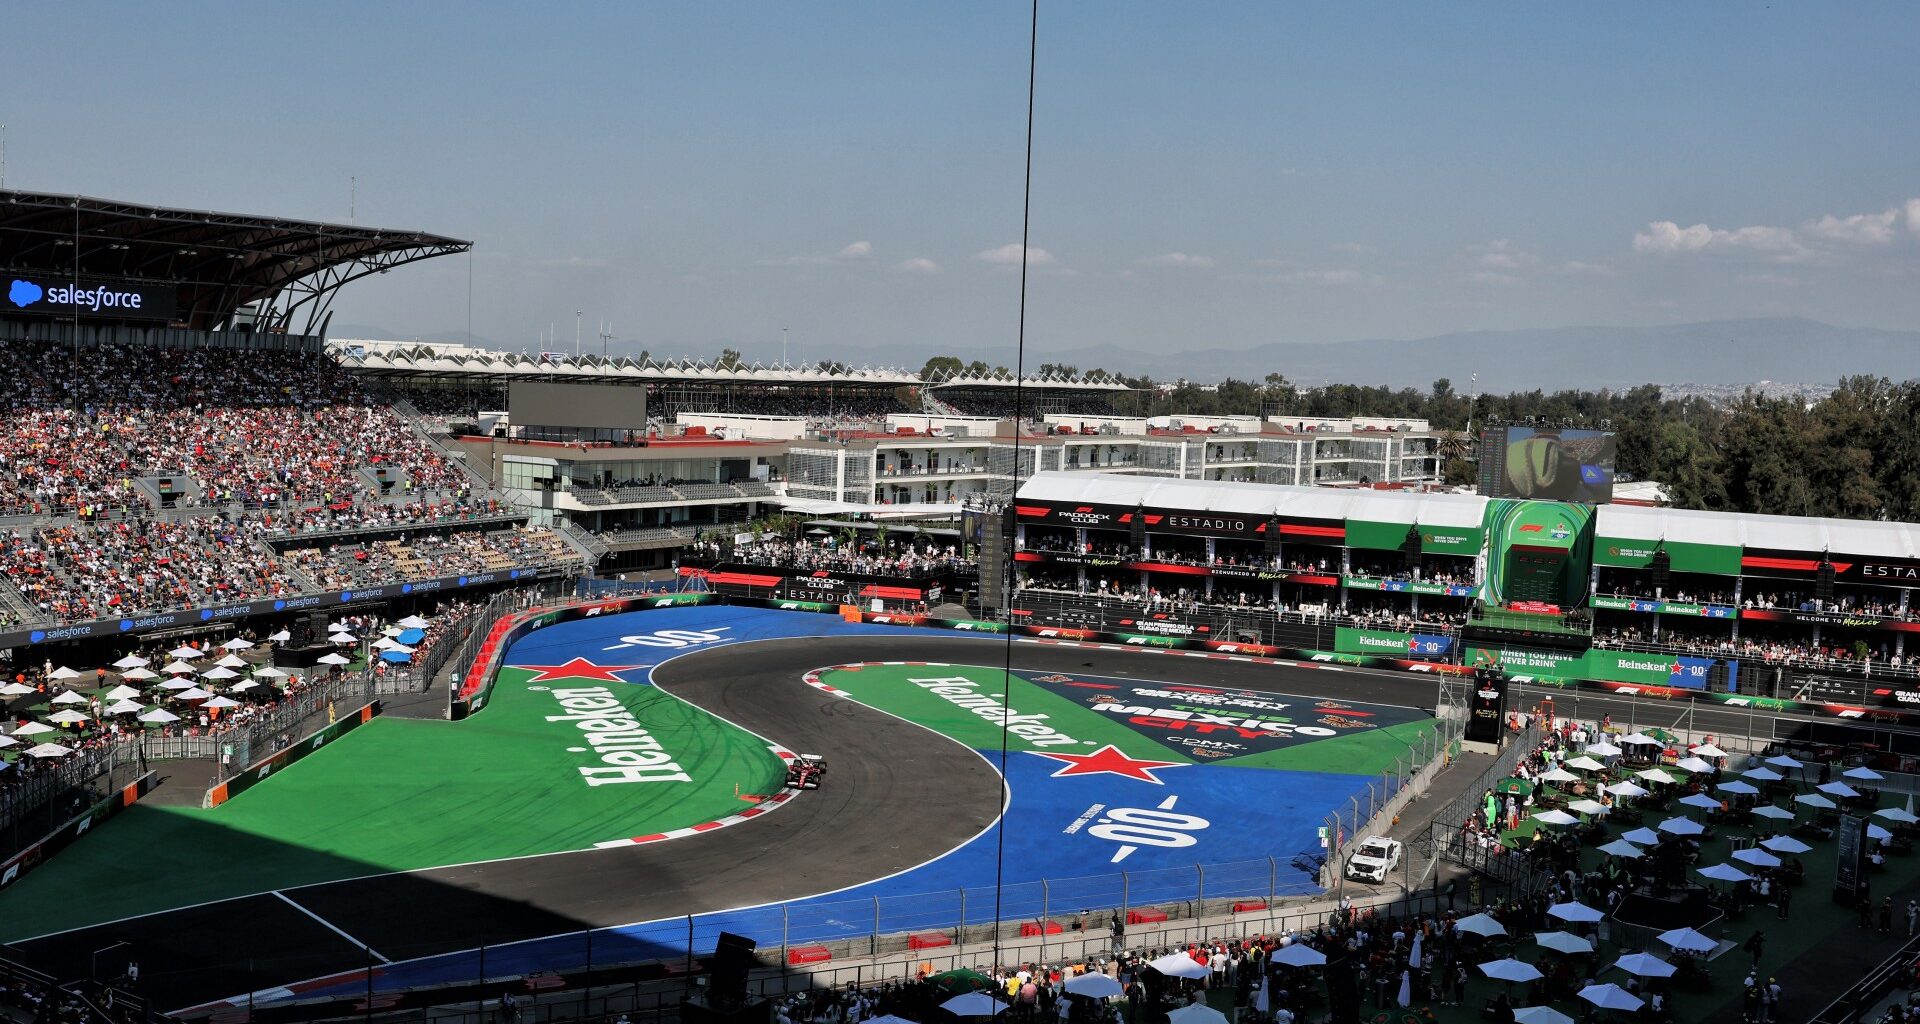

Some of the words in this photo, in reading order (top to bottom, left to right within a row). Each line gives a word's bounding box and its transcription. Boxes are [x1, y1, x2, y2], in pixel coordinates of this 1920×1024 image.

[47, 283, 141, 312] salesforce
[1058, 511, 1110, 520] PADDOCK
[1169, 516, 1244, 531] ESTADIO
[1092, 558, 1120, 566] Mexico
[1258, 572, 1289, 580] Mexico
[1863, 565, 1917, 578] ESTA
[468, 574, 495, 585] salesforce
[796, 576, 845, 586] PADDOCK
[1348, 580, 1376, 588] Heineken
[412, 581, 441, 592] salesforce
[1412, 585, 1442, 593] Heineken
[352, 588, 383, 600] salesforce
[790, 590, 849, 603] ESTADIO
[286, 596, 320, 608] salesforce
[214, 605, 251, 618] salesforce
[1665, 606, 1697, 614] Heineken
[134, 614, 175, 628] salesforce
[1842, 618, 1881, 626] Mexico
[47, 625, 91, 639] salesforce
[1360, 636, 1404, 648] Heineken
[1500, 649, 1526, 657] WHEN
[1528, 651, 1546, 659] YOU
[1548, 653, 1573, 662] DRIVE
[1500, 656, 1527, 665] NEVER
[1529, 659, 1556, 668] DRINK
[1617, 659, 1667, 671] Heineken
[1894, 690, 1918, 698] GRAN
[907, 676, 1079, 748] Heineken
[1170, 704, 1254, 718] THIS
[1256, 714, 1293, 723] IS
[1090, 702, 1337, 736] MEXICO
[1128, 716, 1273, 739] CITY
[545, 686, 693, 787] Heineken
[1166, 736, 1243, 749] CDMX
